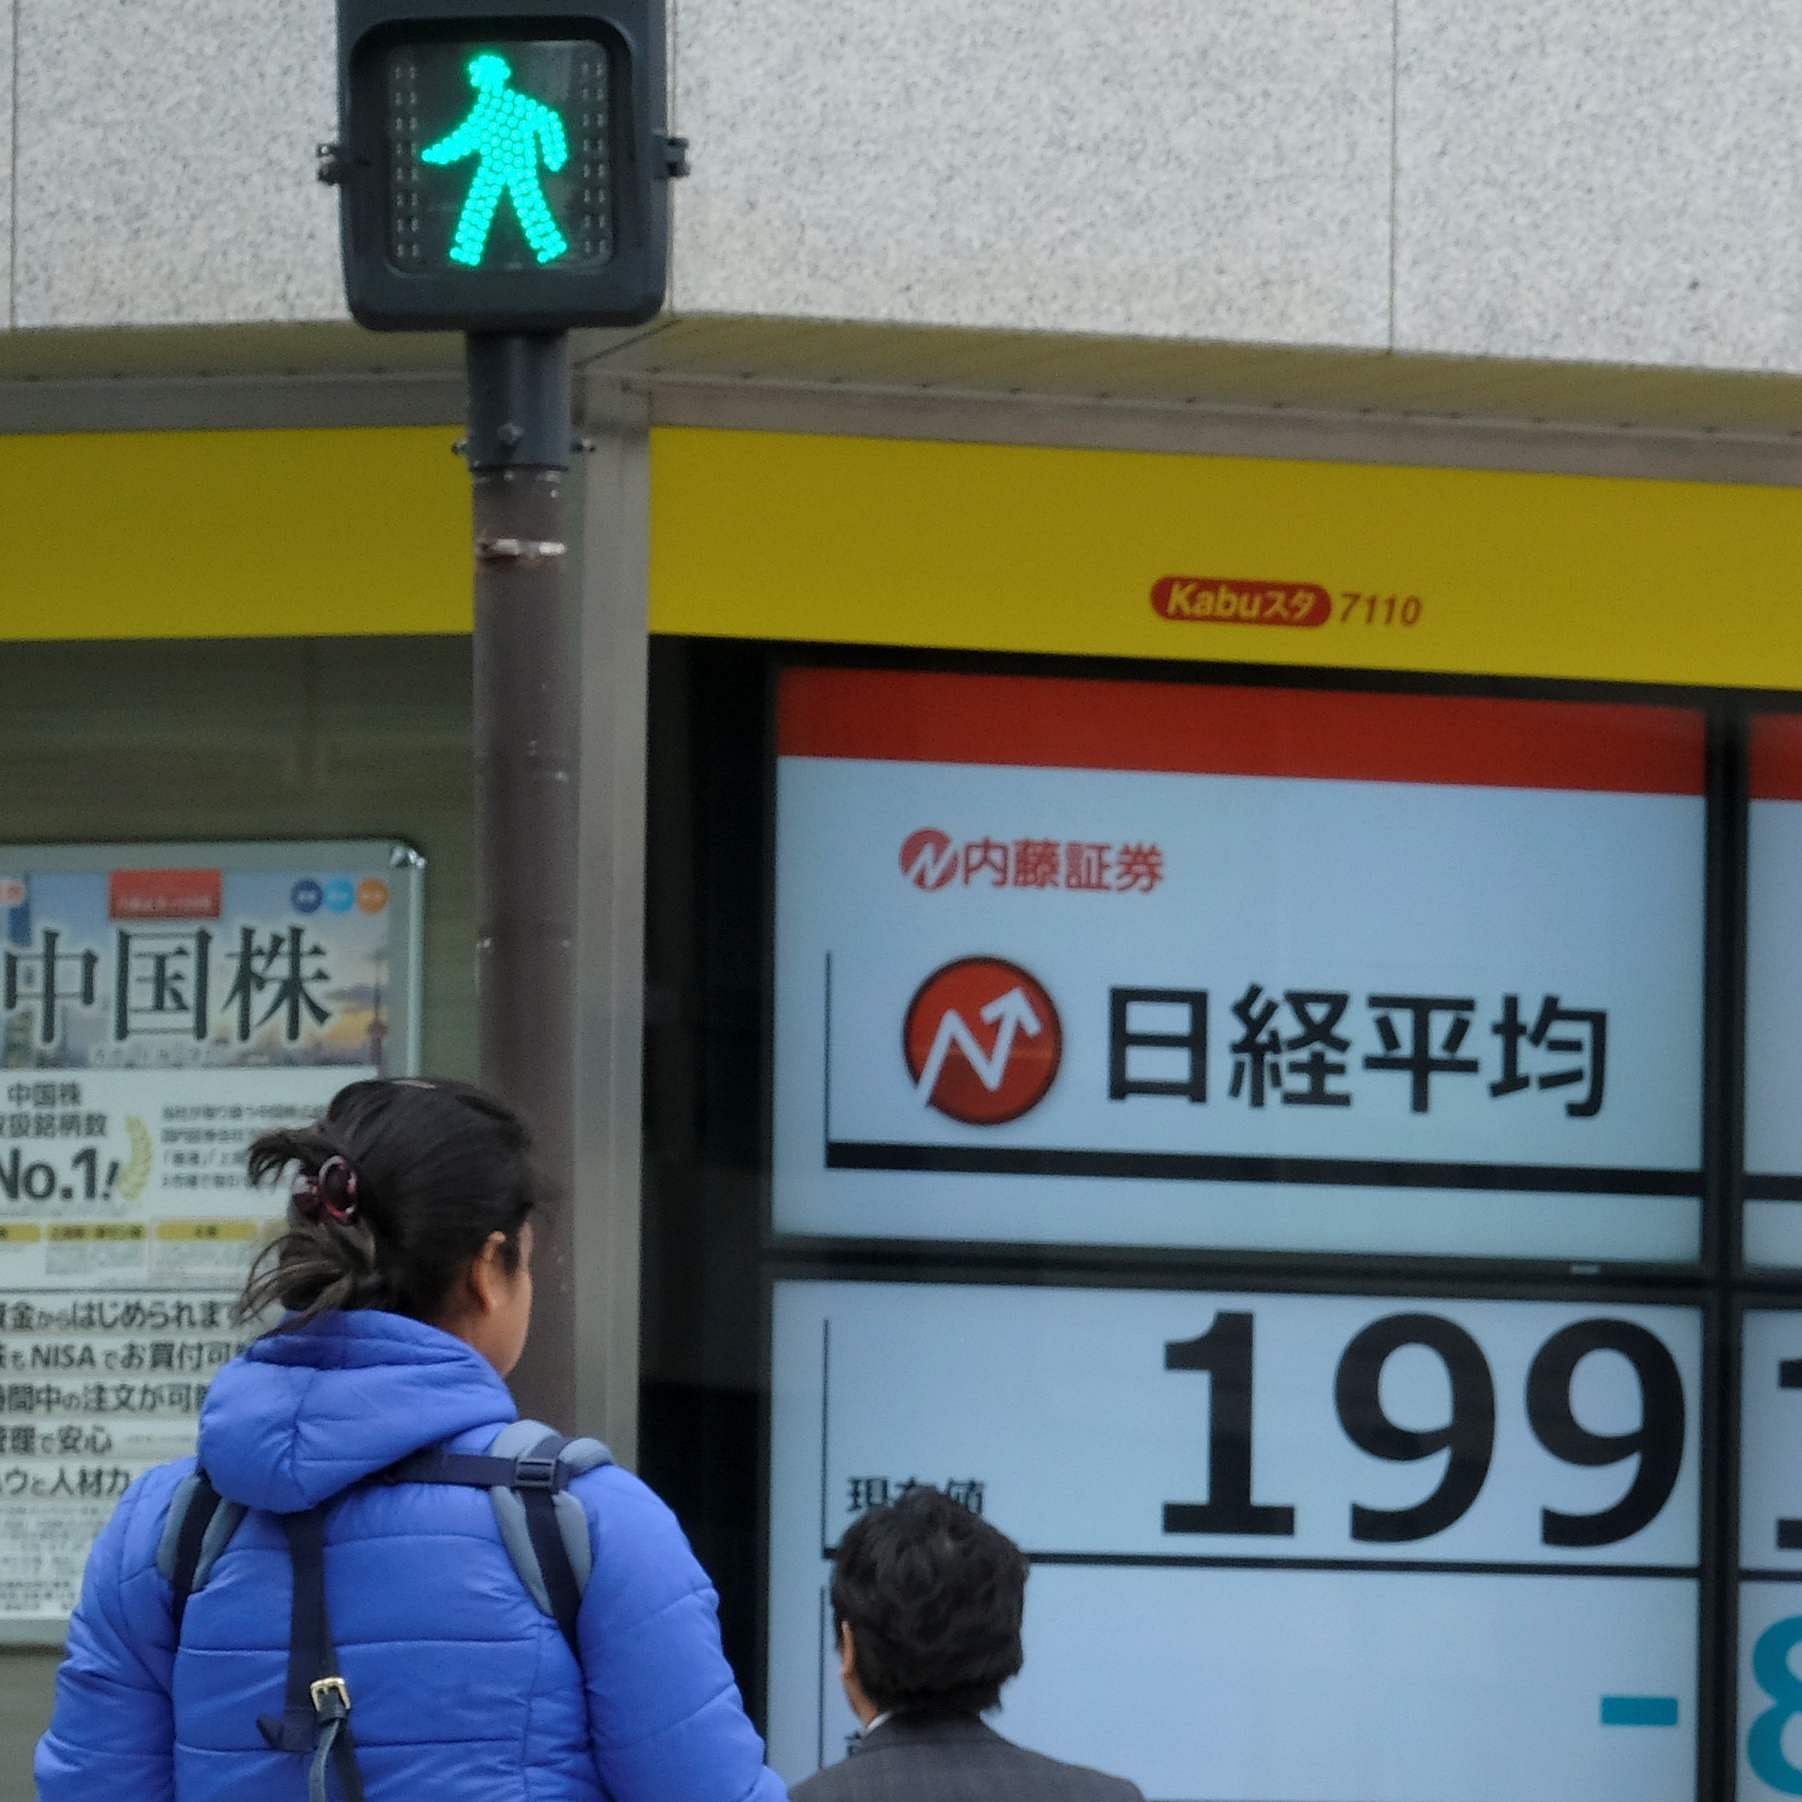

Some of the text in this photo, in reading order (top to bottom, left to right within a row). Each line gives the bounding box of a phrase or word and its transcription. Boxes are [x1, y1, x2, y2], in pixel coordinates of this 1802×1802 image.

[1165, 583, 1422, 626] Kabuスタ 7110
[961, 836, 1166, 897] 内藤証券
[3, 926, 333, 1043] 中国株
[1107, 983, 1610, 1120] 日経平均
